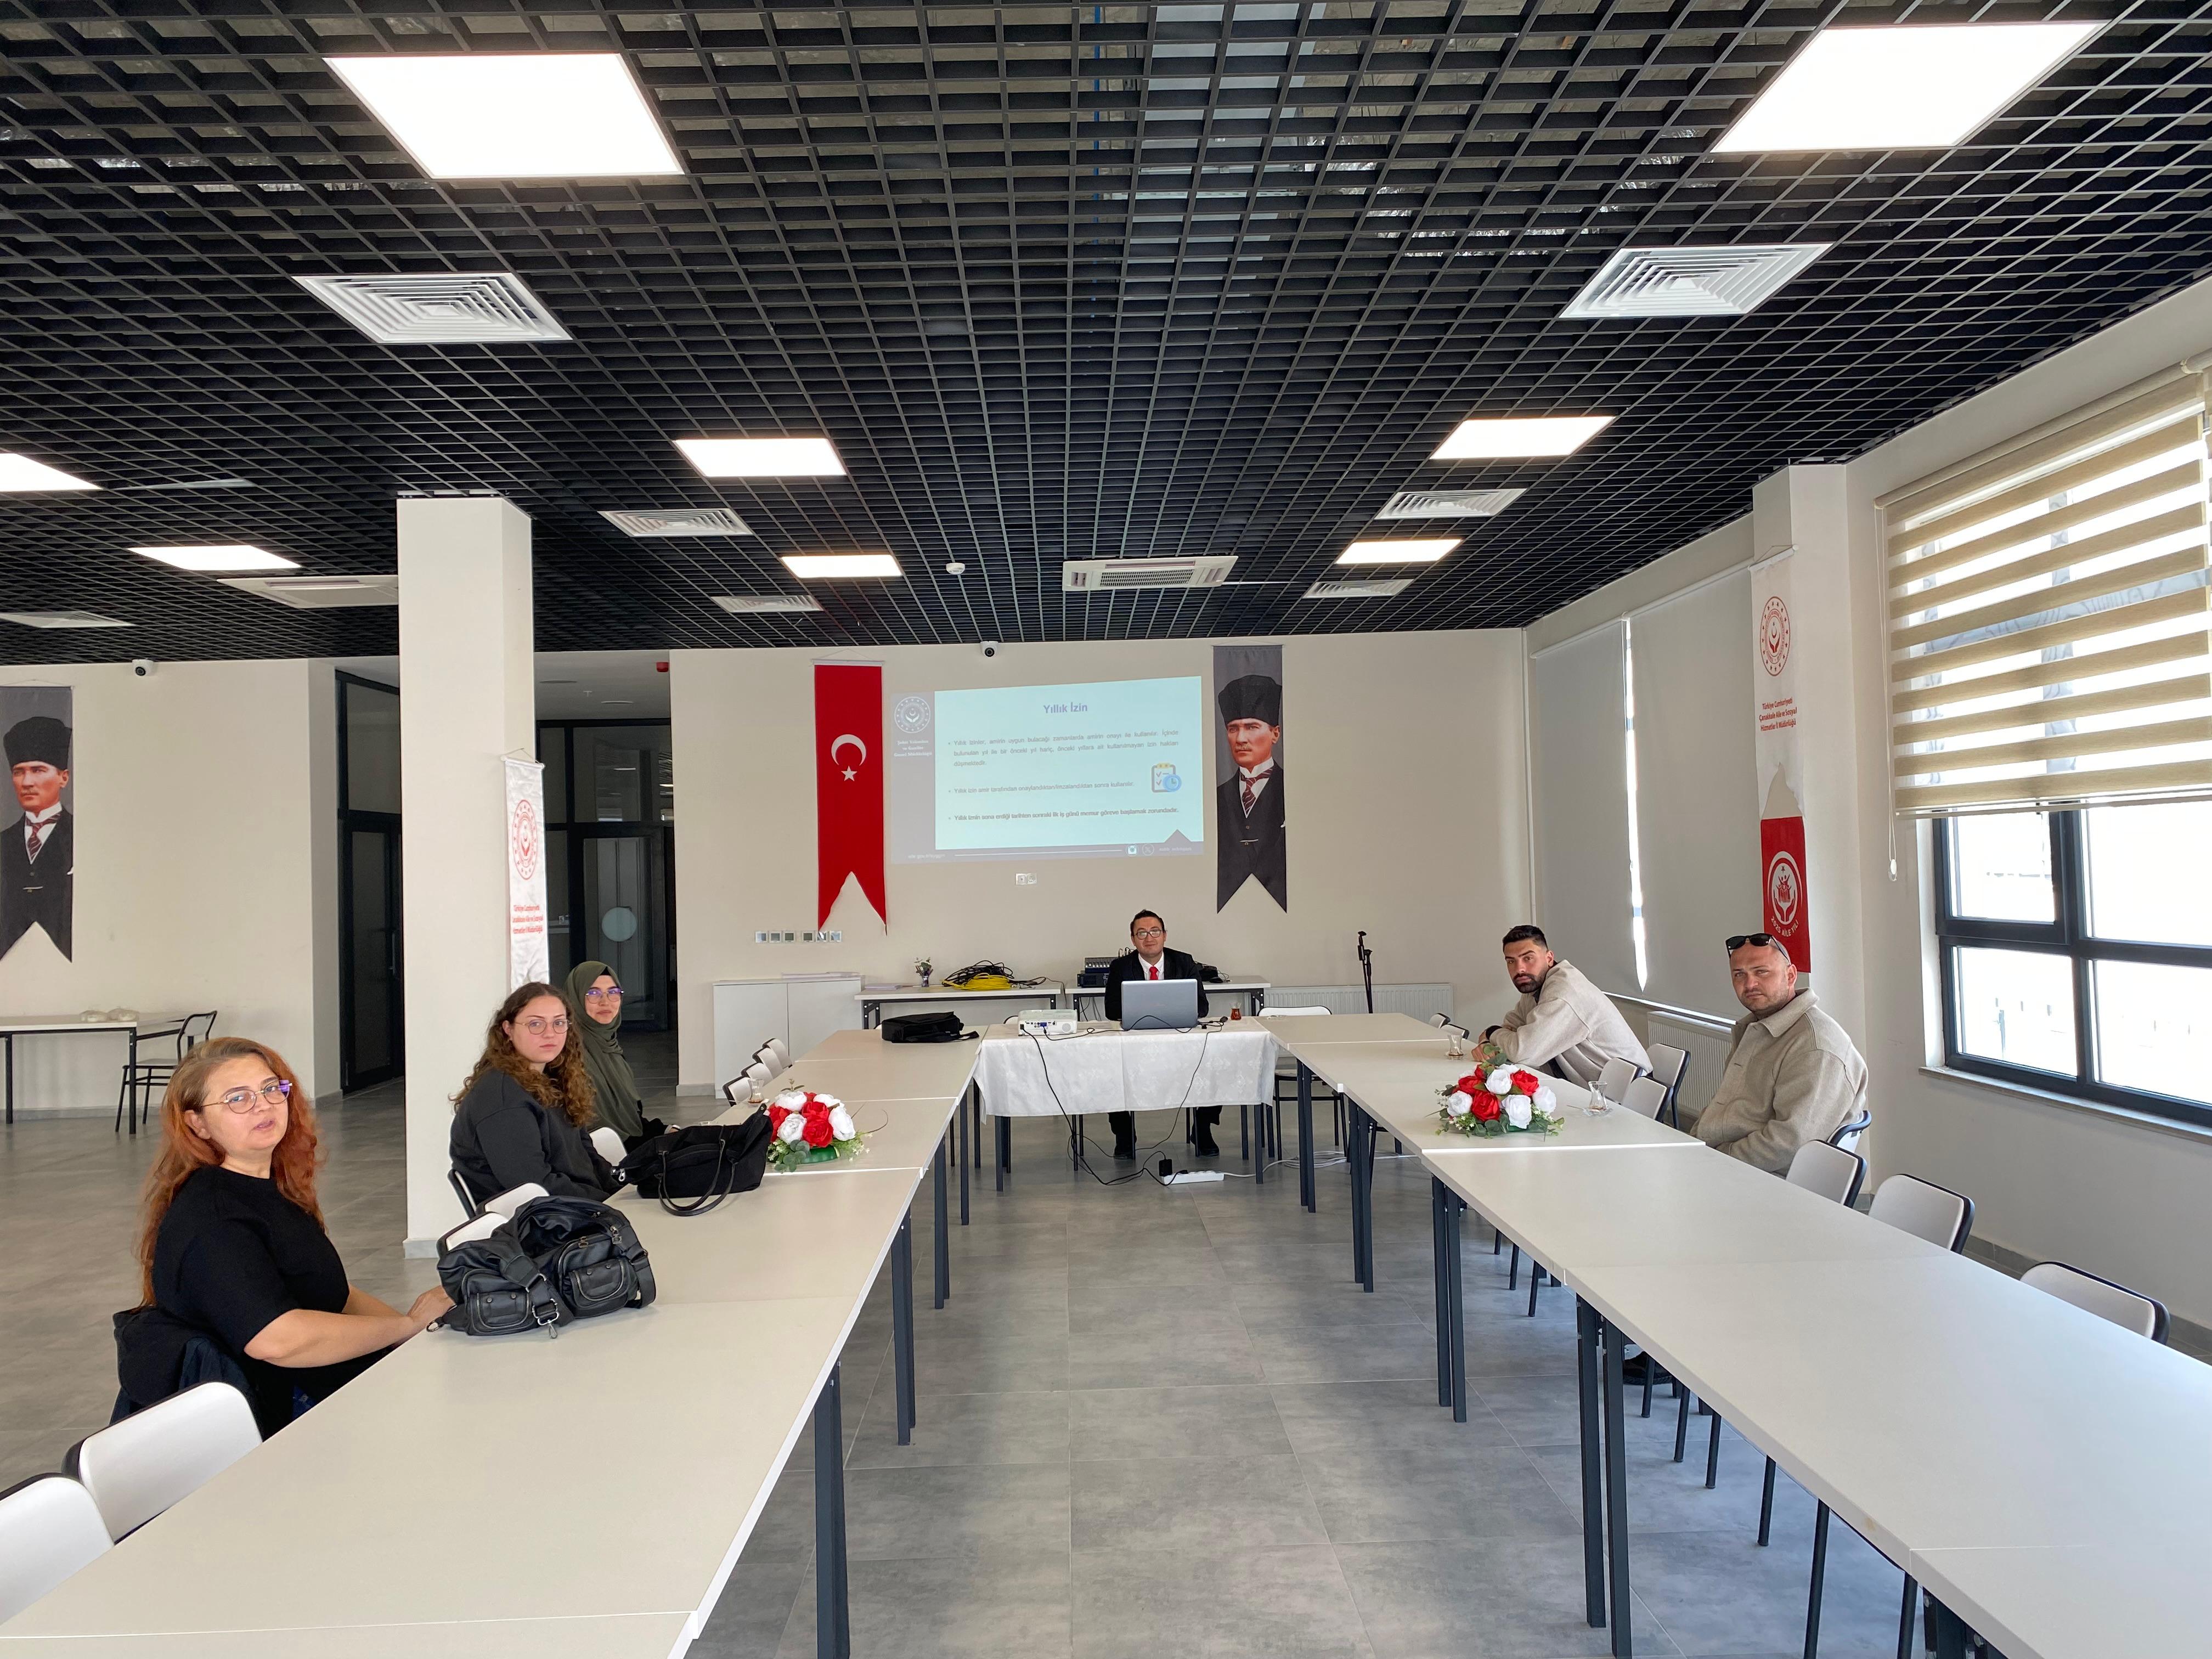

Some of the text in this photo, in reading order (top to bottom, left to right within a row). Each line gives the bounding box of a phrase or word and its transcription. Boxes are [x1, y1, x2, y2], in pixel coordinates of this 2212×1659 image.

[1043, 701, 1087, 713] Yıllık İzin
[1786, 707, 1797, 716] Sosyal
[1771, 916, 1781, 934] 2025
